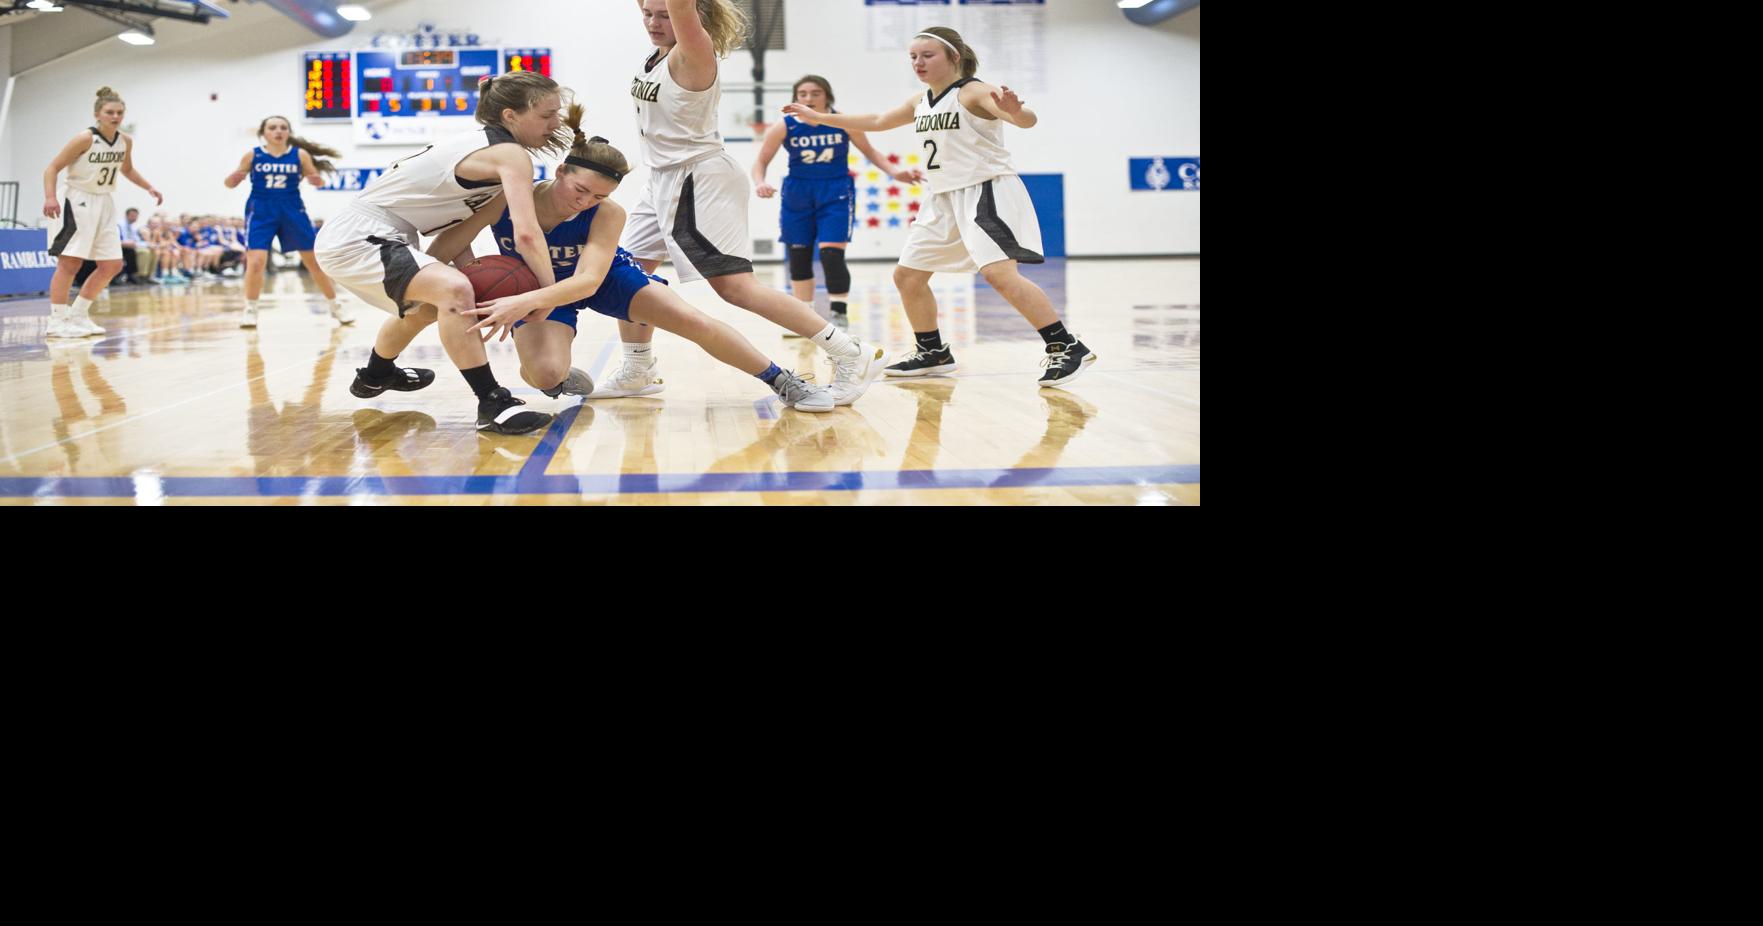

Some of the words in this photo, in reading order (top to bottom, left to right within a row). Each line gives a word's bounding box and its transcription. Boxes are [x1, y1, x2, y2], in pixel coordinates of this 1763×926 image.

[914, 111, 960, 133] LEDONIA
[790, 133, 843, 148] COTTER
[800, 147, 834, 165] 24
[923, 139, 941, 170] 2
[97, 166, 117, 186] 31
[255, 163, 298, 173] COTTER
[264, 174, 288, 189] 12
